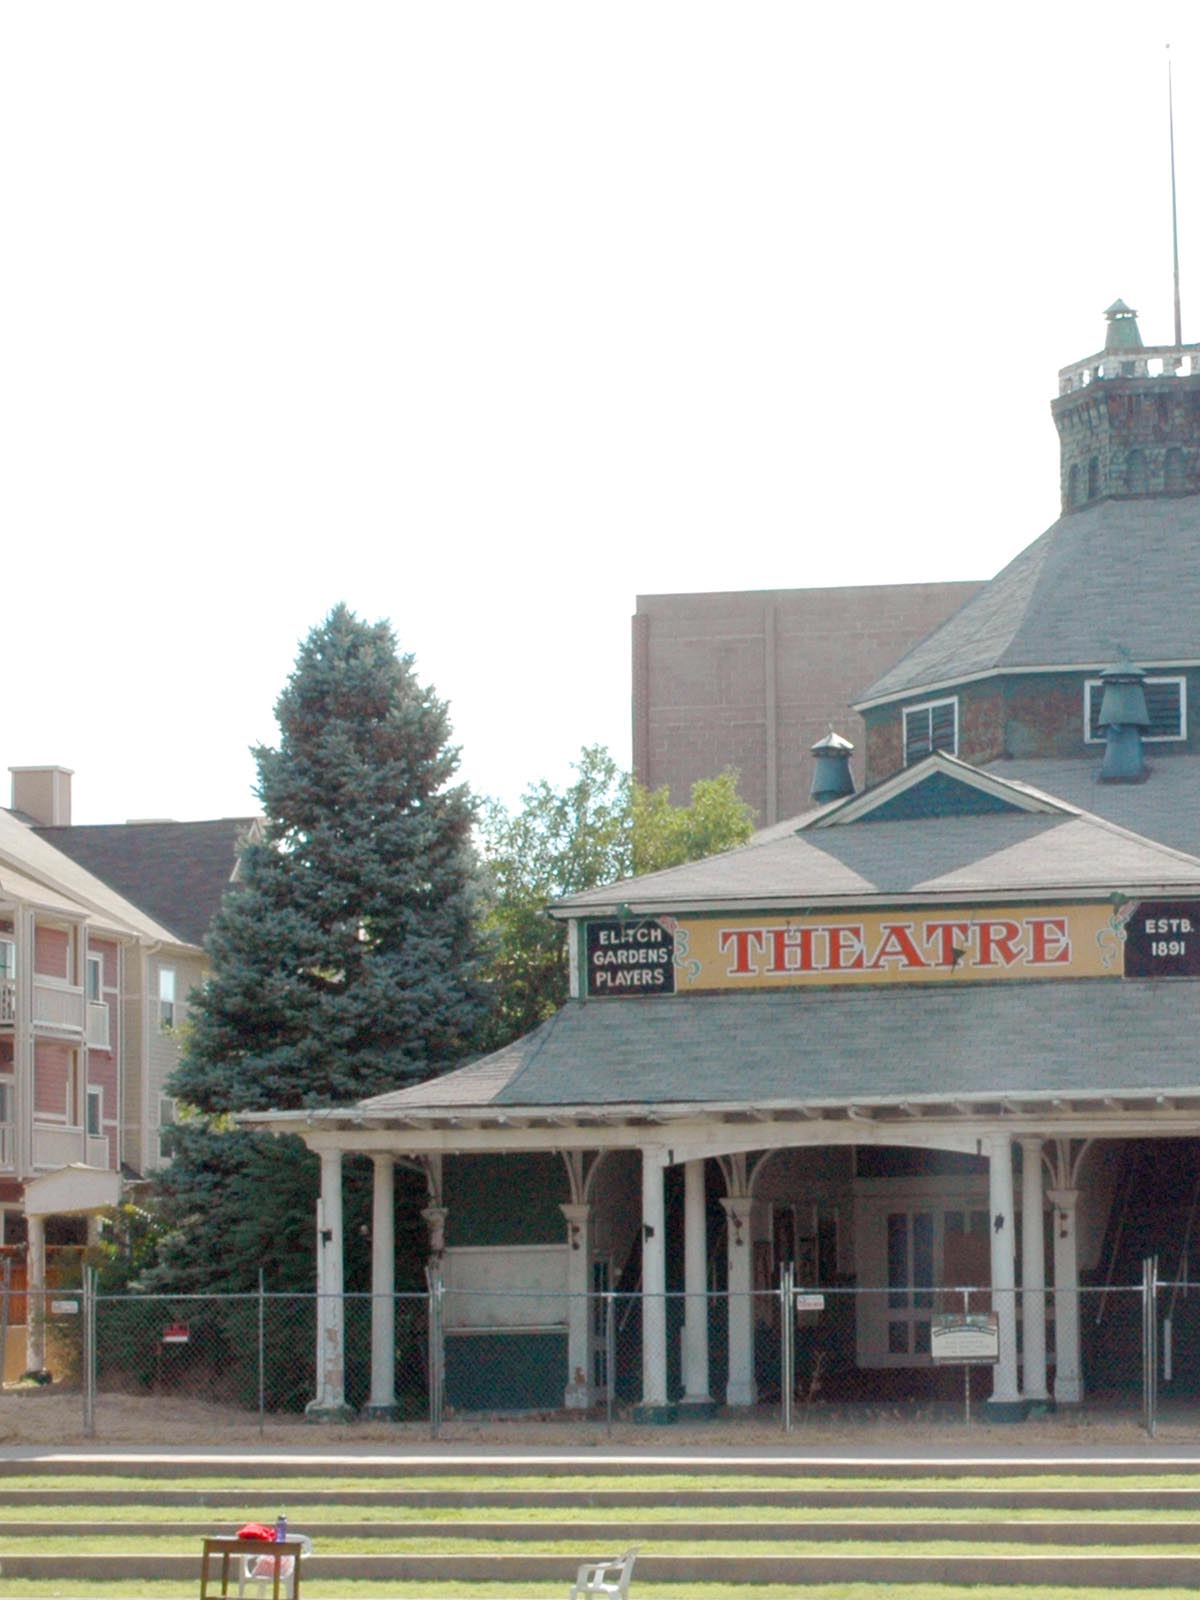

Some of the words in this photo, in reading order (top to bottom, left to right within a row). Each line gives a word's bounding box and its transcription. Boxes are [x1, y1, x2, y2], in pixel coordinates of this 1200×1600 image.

[1145, 918, 1195, 934] ESTB.
[719, 916, 1072, 976] THEATRE
[1151, 941, 1185, 956] 1891
[596, 968, 664, 987] PLAYERS
